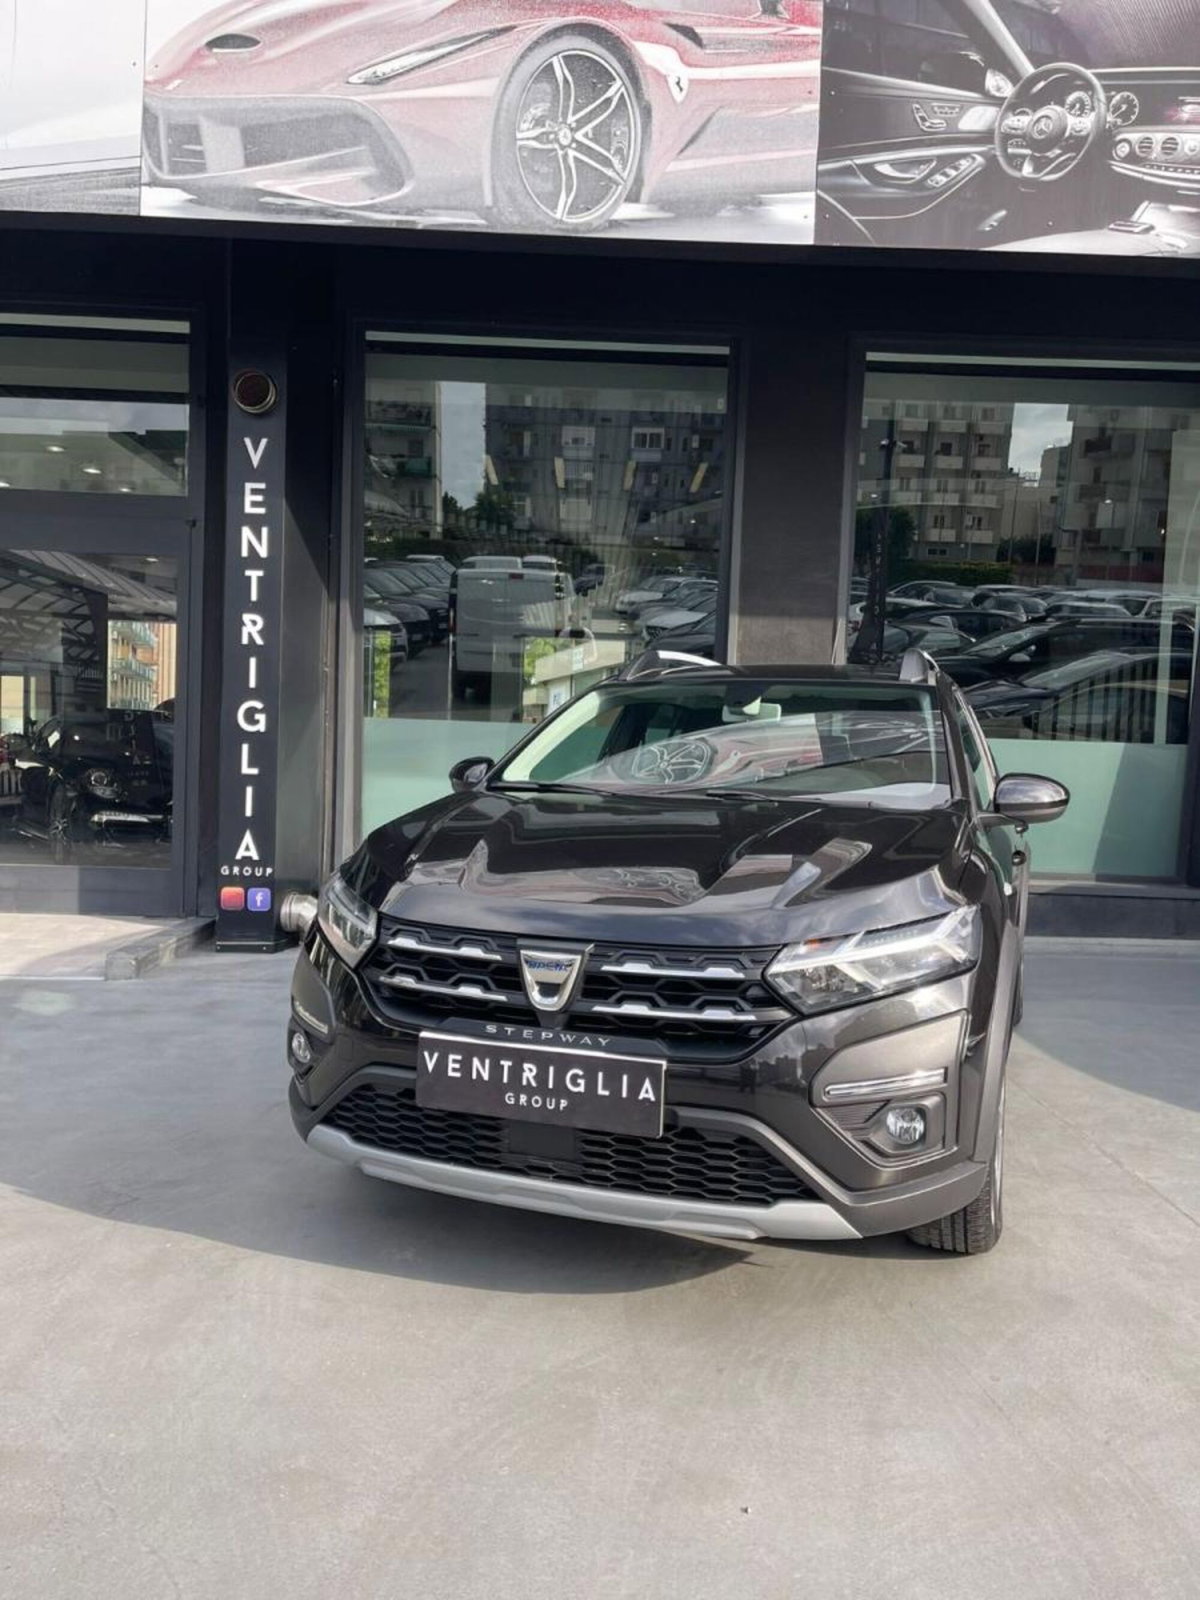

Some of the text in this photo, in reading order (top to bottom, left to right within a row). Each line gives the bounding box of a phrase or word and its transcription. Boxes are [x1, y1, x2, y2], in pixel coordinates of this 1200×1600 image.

[236, 437, 268, 860] VENTRIGLIA
[220, 865, 273, 876] GROUP
[485, 1024, 611, 1047] STEPWAY
[423, 1051, 656, 1102] VENTRIGLIA
[504, 1092, 569, 1111] GROUP
